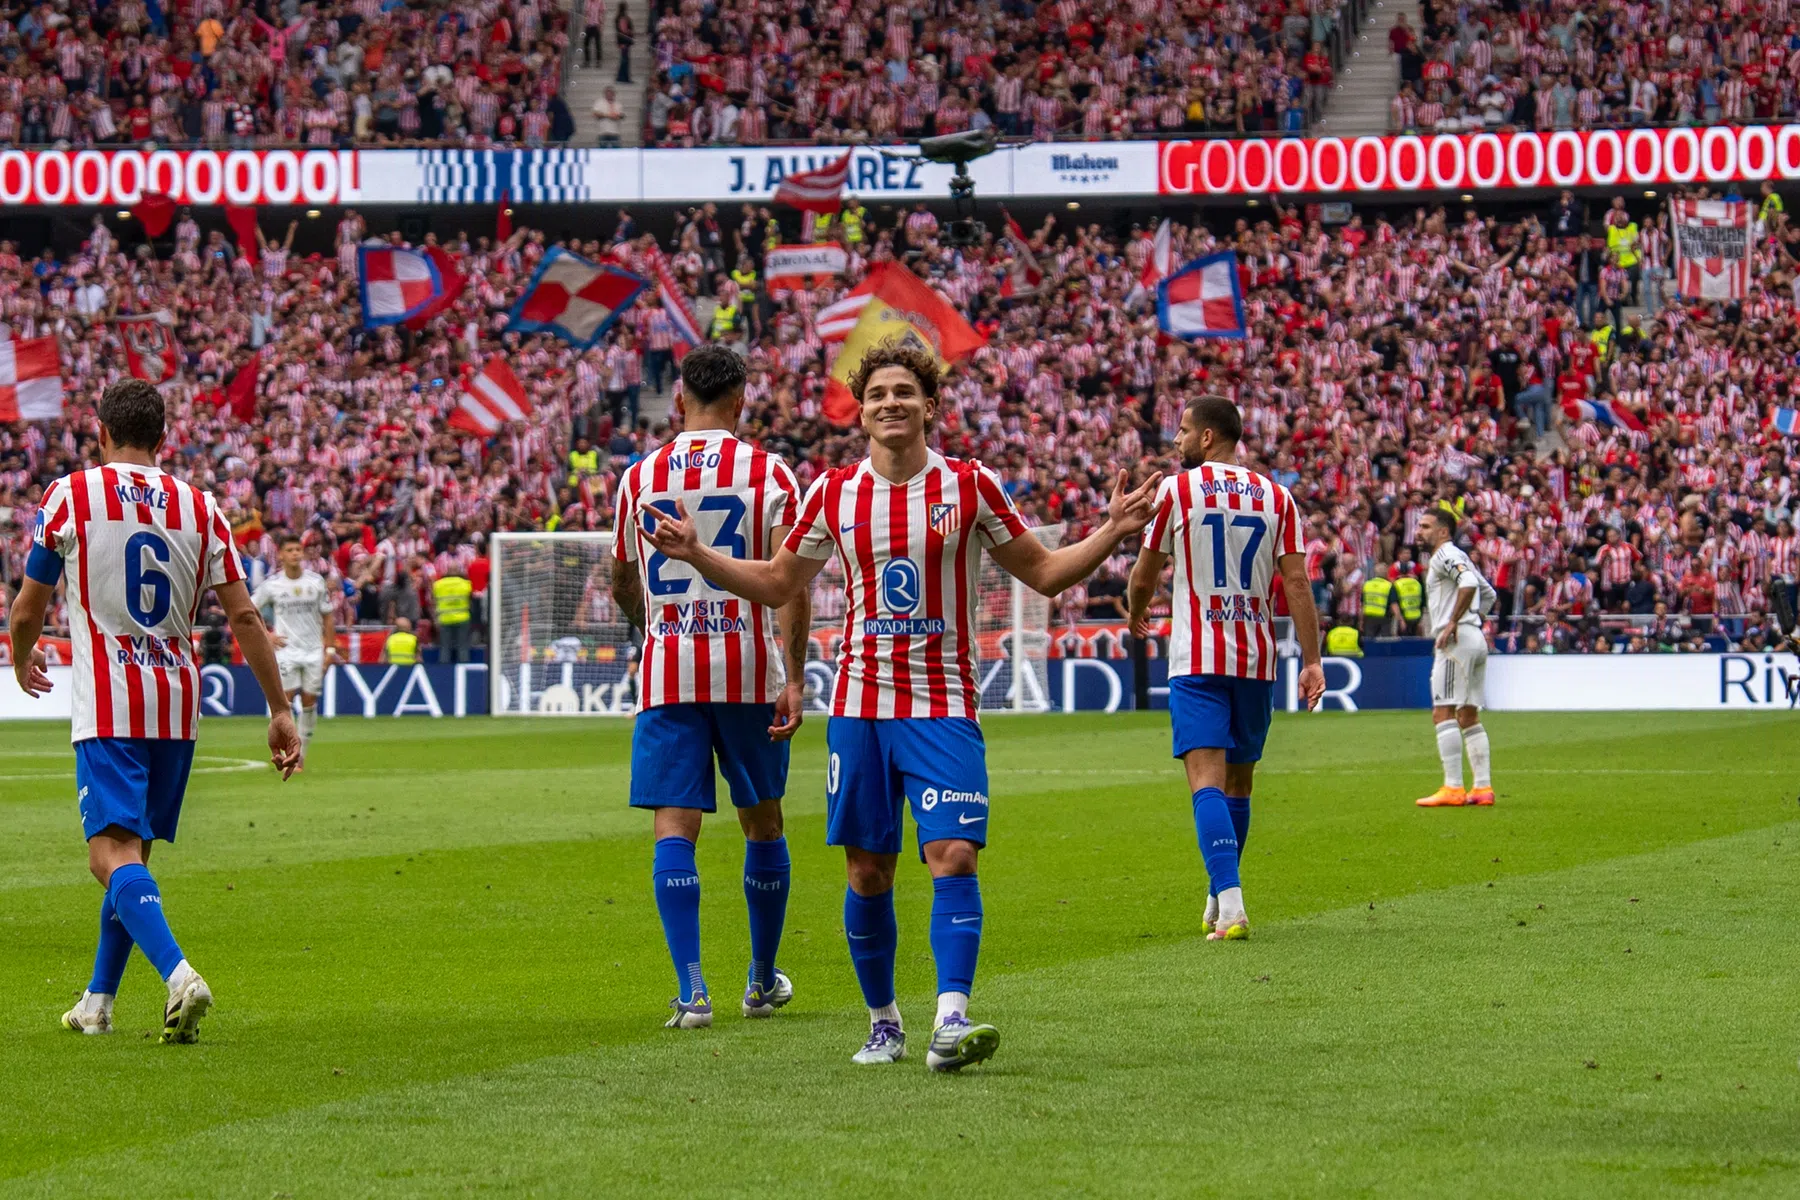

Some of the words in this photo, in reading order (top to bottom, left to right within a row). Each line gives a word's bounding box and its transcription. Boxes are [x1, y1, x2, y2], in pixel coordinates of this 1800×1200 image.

[1051, 152, 1119, 170] Mahou
[729, 156, 756, 191] J.
[764, 154, 923, 190] AREZ
[668, 452, 721, 471] NICO
[116, 484, 170, 510] KOKE
[1200, 479, 1265, 500] HANCKO
[1201, 513, 1267, 590] 17
[124, 531, 171, 628] 6
[676, 601, 727, 618] VISIT
[658, 618, 747, 636] RWANDA
[866, 619, 914, 634] RIYADH
[919, 619, 943, 634] AIR
[745, 875, 780, 891] ATLETI
